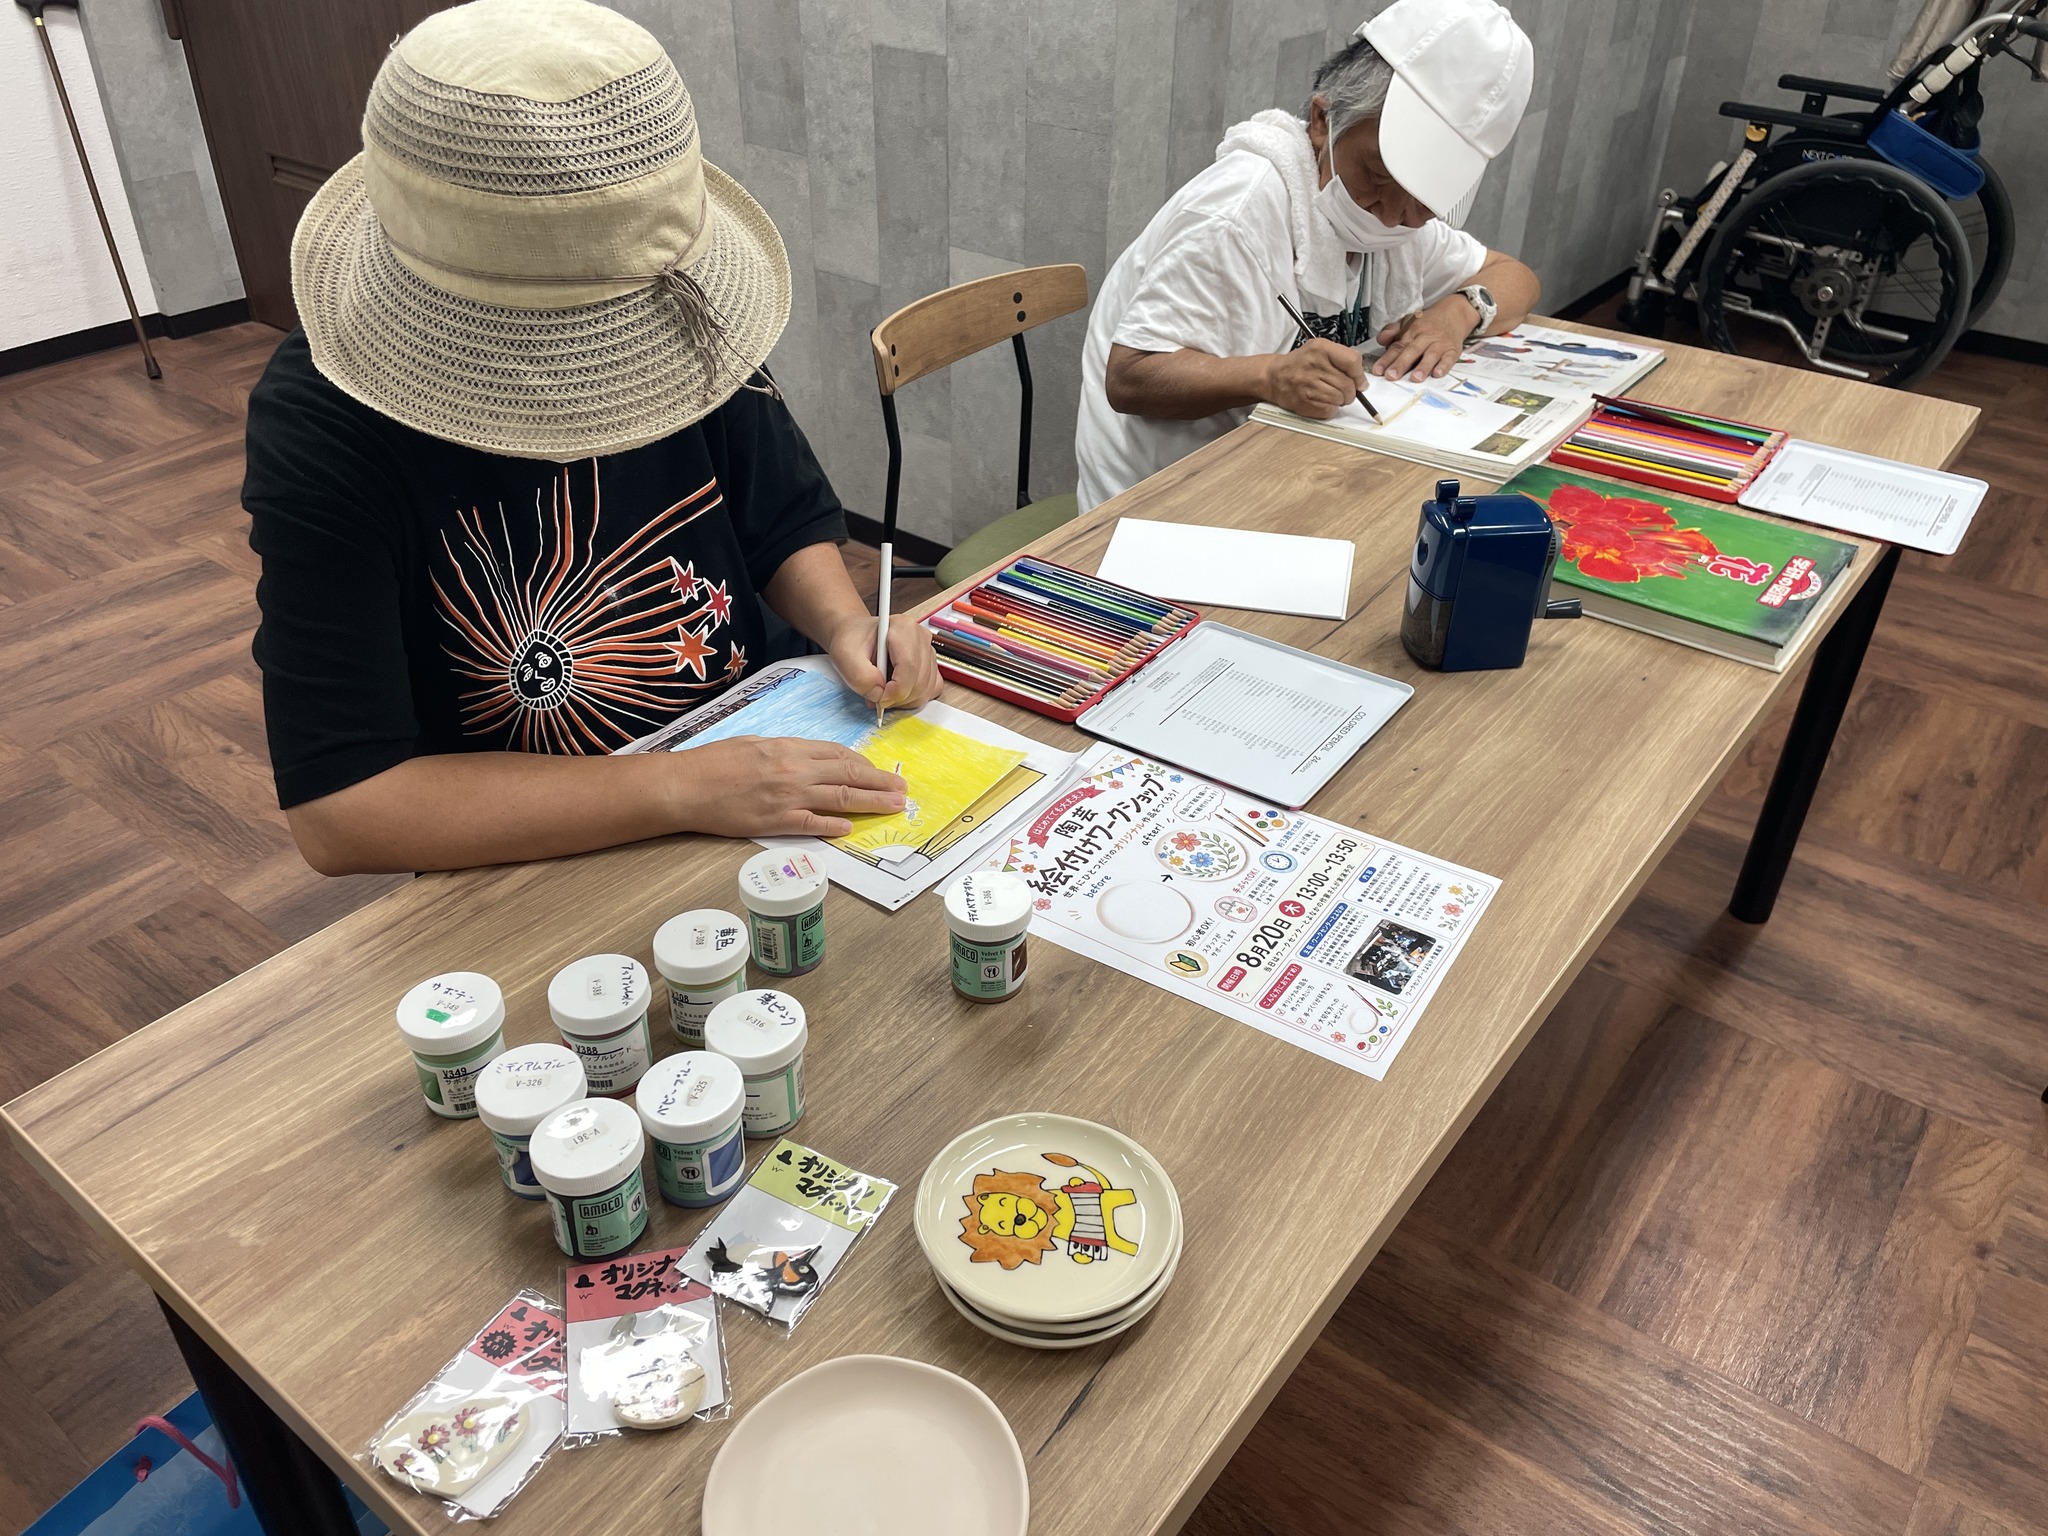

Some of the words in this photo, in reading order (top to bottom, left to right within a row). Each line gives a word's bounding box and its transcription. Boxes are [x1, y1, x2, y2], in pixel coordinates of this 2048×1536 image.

[1707, 555, 1774, 586] 花
[1339, 711, 1366, 734] COLORED
[1320, 733, 1343, 751] PENCIL
[1054, 806, 1097, 838] 陶芸
[1027, 774, 1162, 894] 絵付けワークショップ
[1141, 822, 1164, 845] after!
[1083, 875, 1111, 897] before
[715, 927, 738, 951] 黄色
[1236, 918, 1291, 967] 8月20日
[1284, 903, 1300, 915] 木
[745, 1014, 765, 1028] V-316
[442, 1067, 468, 1080] V349
[515, 1078, 543, 1088] V-326
[690, 1080, 708, 1100] V-325
[573, 1128, 601, 1145] V-361
[583, 1196, 621, 1217] AMACO
[600, 1254, 682, 1285] オリジナ
